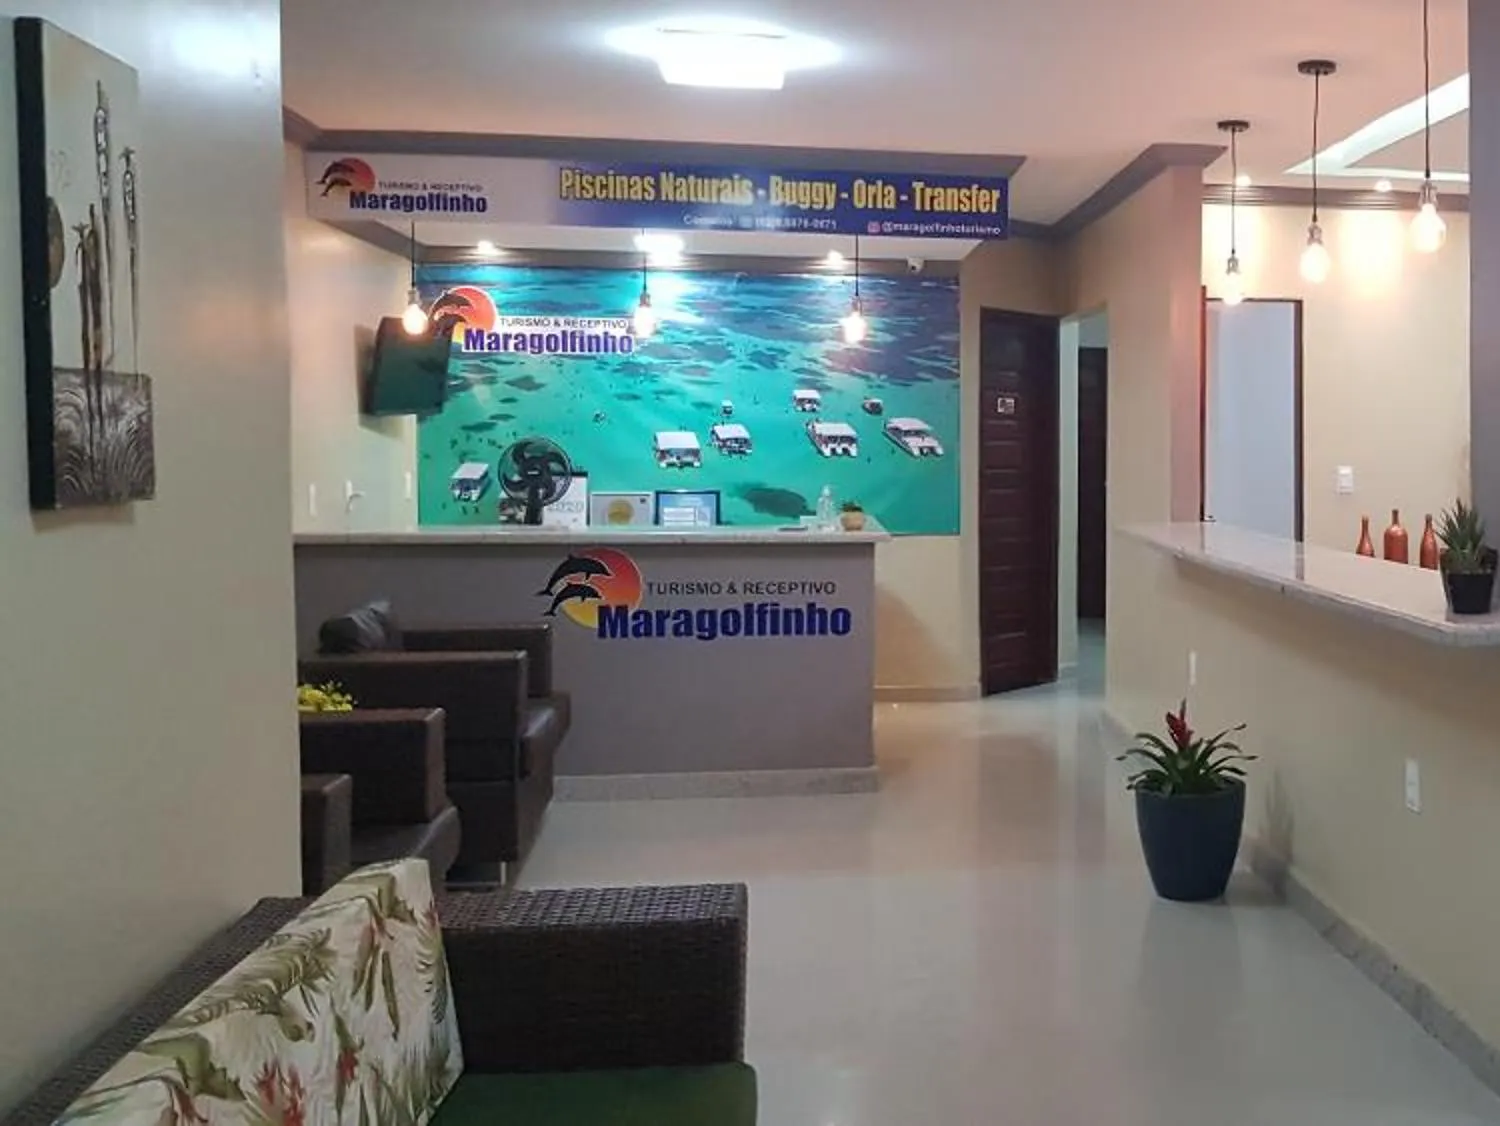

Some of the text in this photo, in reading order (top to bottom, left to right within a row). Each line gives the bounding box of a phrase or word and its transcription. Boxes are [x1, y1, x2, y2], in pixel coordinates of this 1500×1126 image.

[350, 191, 488, 213] Maragolfinho
[559, 168, 655, 200] Piscinas
[659, 171, 754, 206] Naturais
[769, 175, 837, 210] Buggy
[853, 178, 896, 210] Orla
[912, 181, 1000, 214] Transfer
[501, 317, 627, 329] TURISMO & RECEPTIVO
[464, 328, 633, 355] Maragolfinho
[647, 580, 837, 596] TURISMO & RECEPTIVO
[597, 602, 852, 641] Maragolfinho
